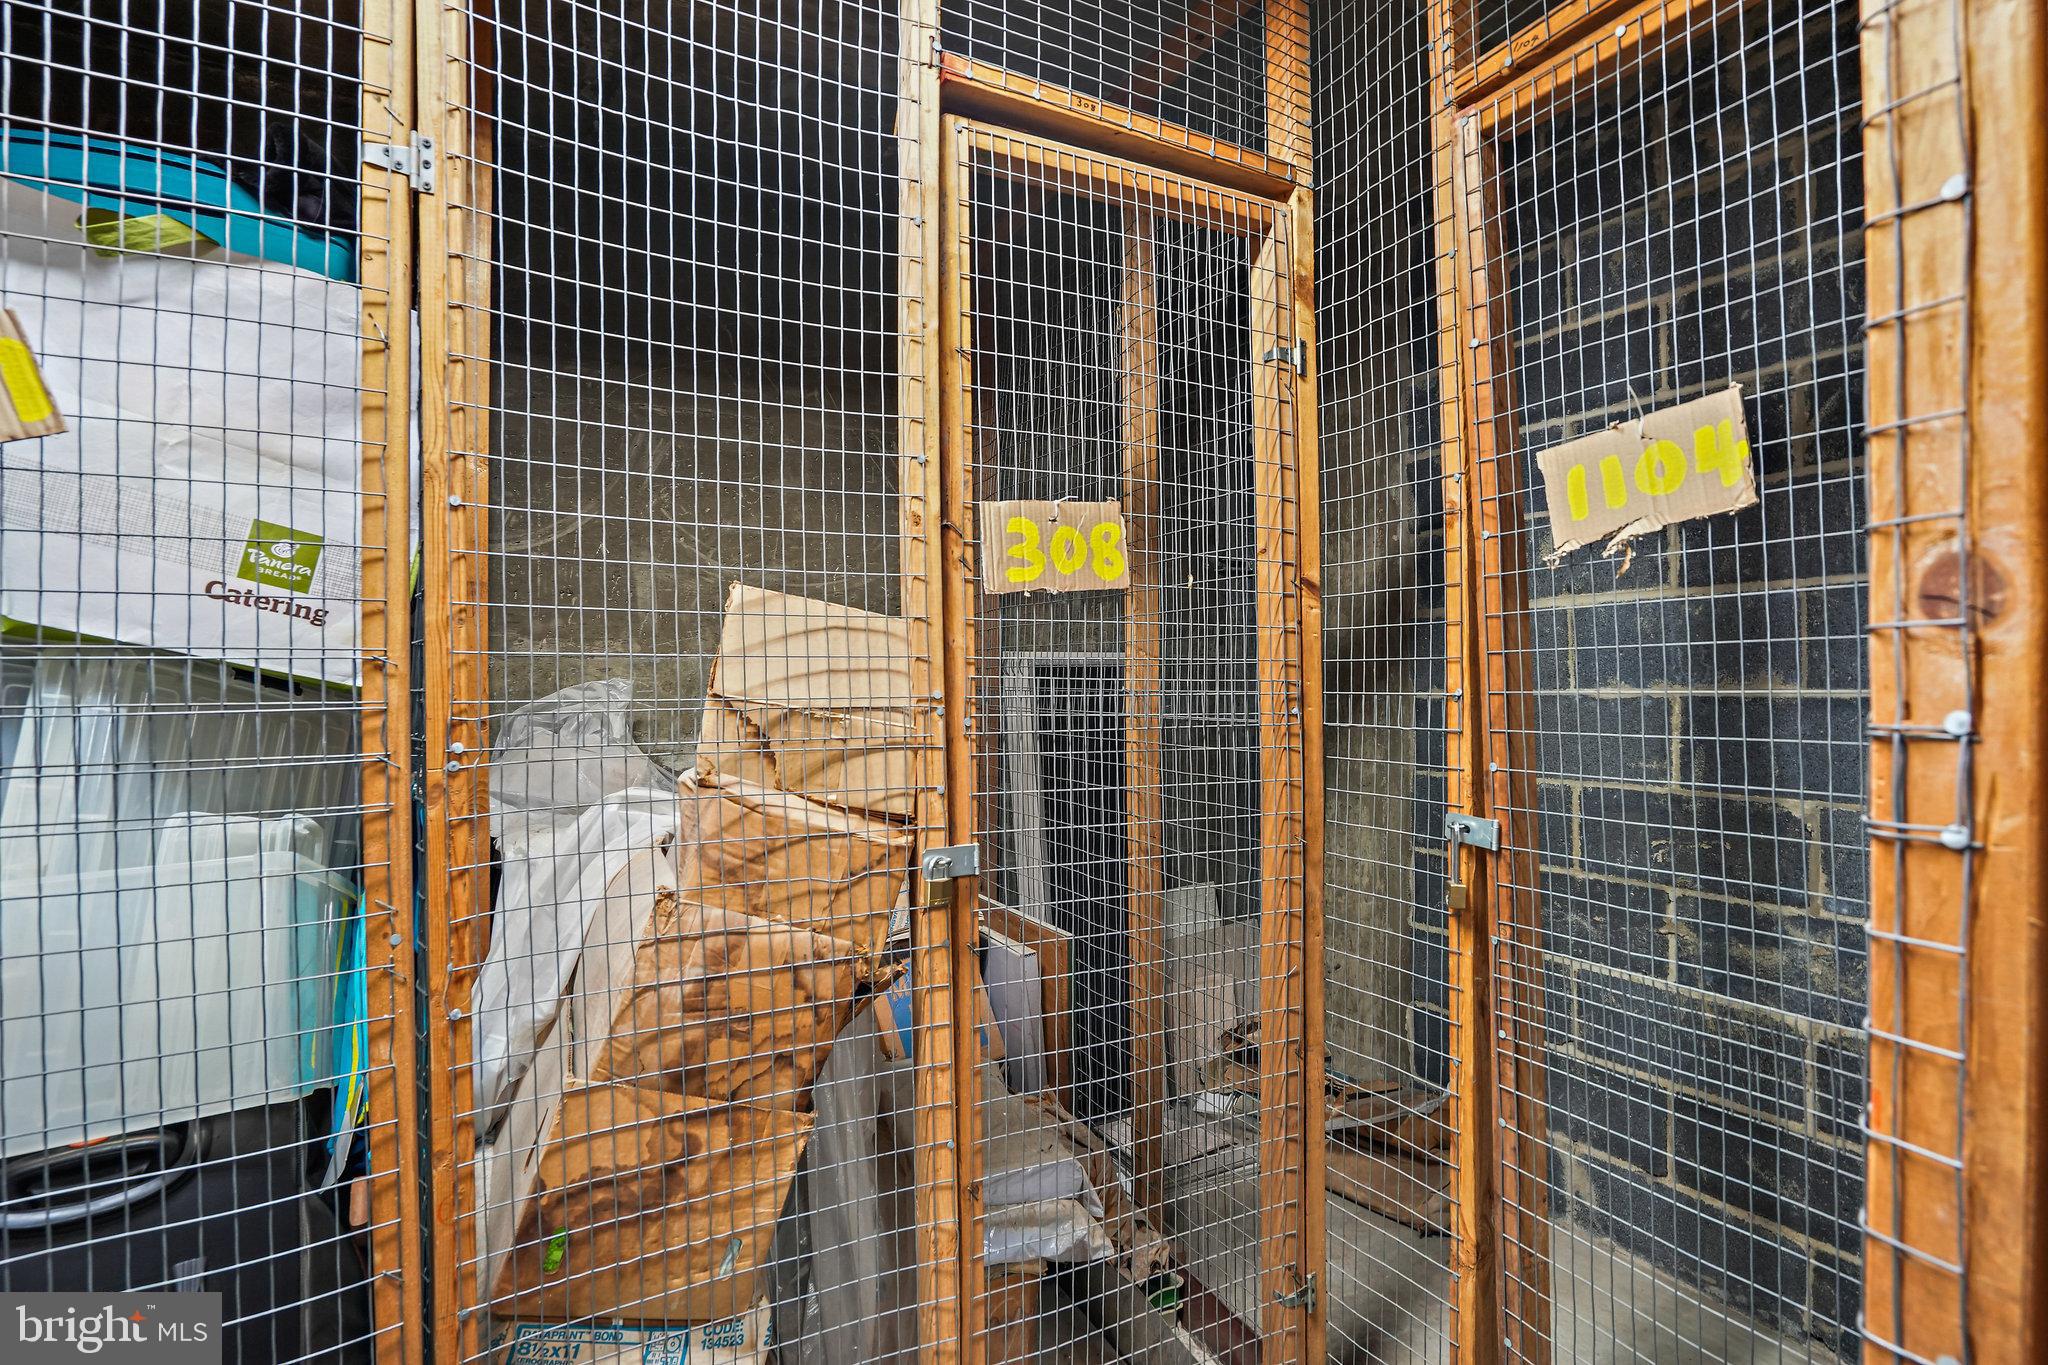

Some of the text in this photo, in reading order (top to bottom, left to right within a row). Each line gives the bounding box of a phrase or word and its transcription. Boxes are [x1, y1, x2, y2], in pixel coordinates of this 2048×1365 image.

[1076, 96, 1096, 112] 308
[1566, 416, 1750, 522] 1104
[247, 547, 312, 577] Panera
[1005, 516, 1126, 584] 308
[204, 580, 330, 627] Catering
[594, 1331, 624, 1341] BOND
[701, 1334, 744, 1351] 134523
